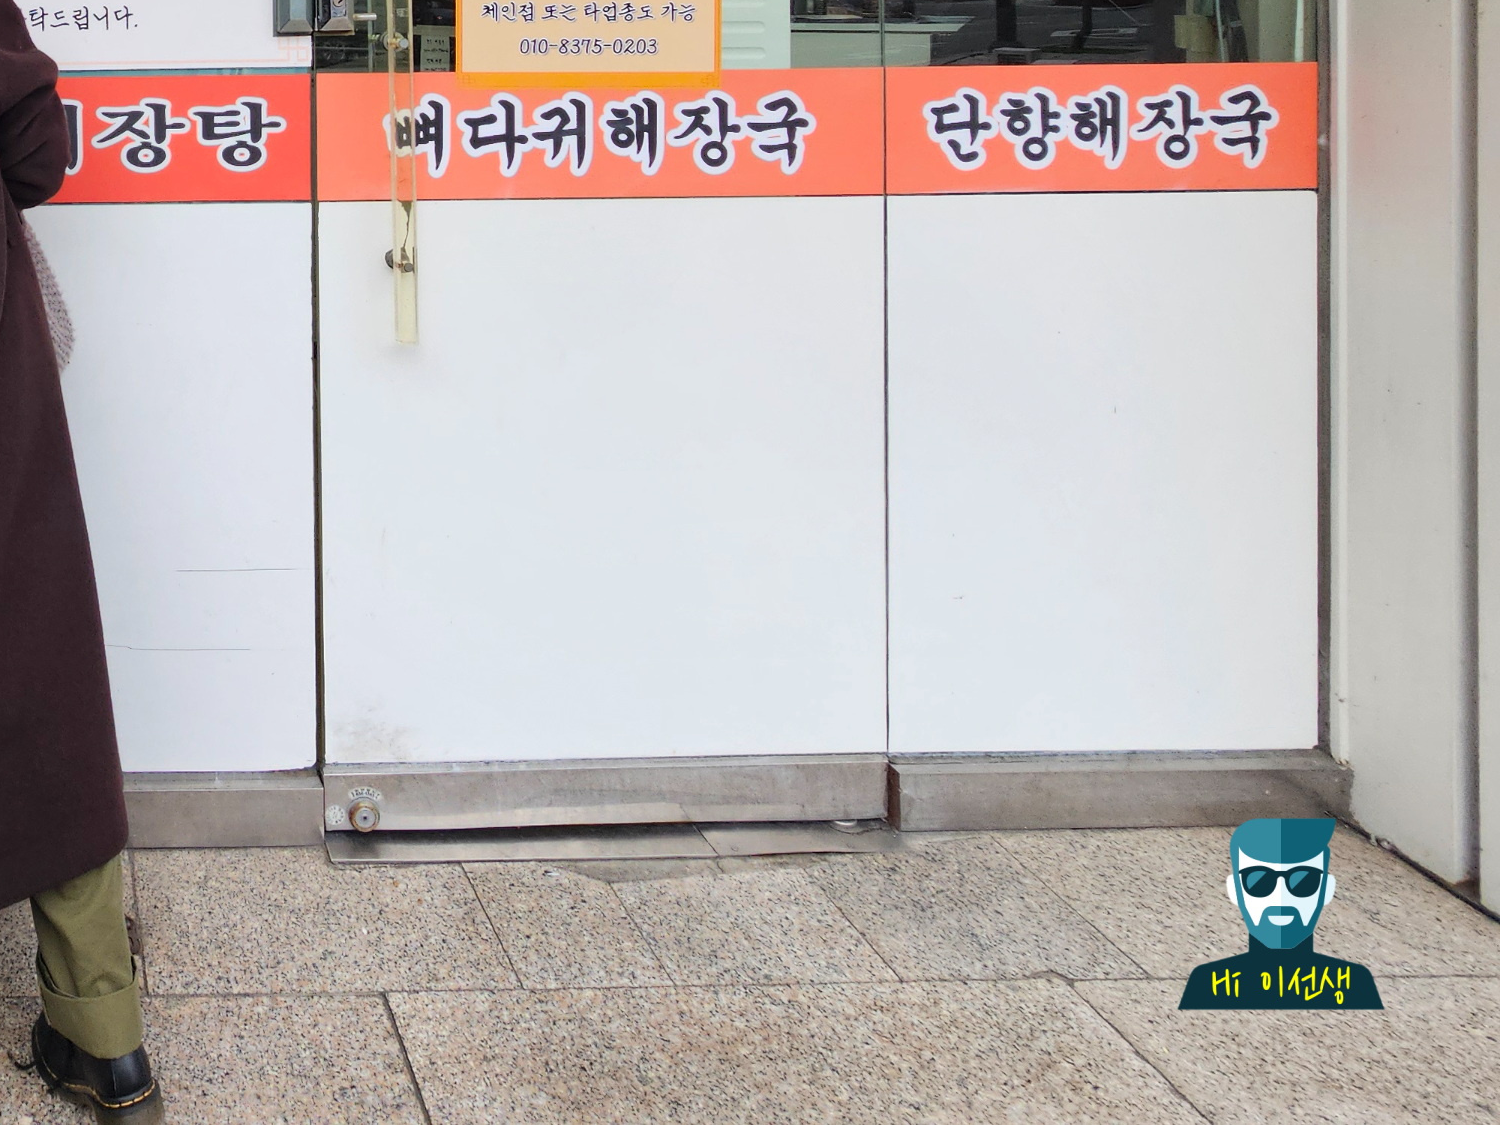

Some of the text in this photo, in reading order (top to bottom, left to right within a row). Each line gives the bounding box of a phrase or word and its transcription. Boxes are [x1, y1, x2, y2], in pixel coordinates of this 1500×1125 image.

[24, 6, 139, 32] 탁드립니다.
[481, 1, 696, 23] 체인점 또는 타업종도 가능
[519, 38, 659, 55] 010-8375-0203
[68, 98, 286, 172] 장탕
[390, 92, 811, 175] 뼈다귀해장국
[927, 88, 1275, 165] 단향해장국
